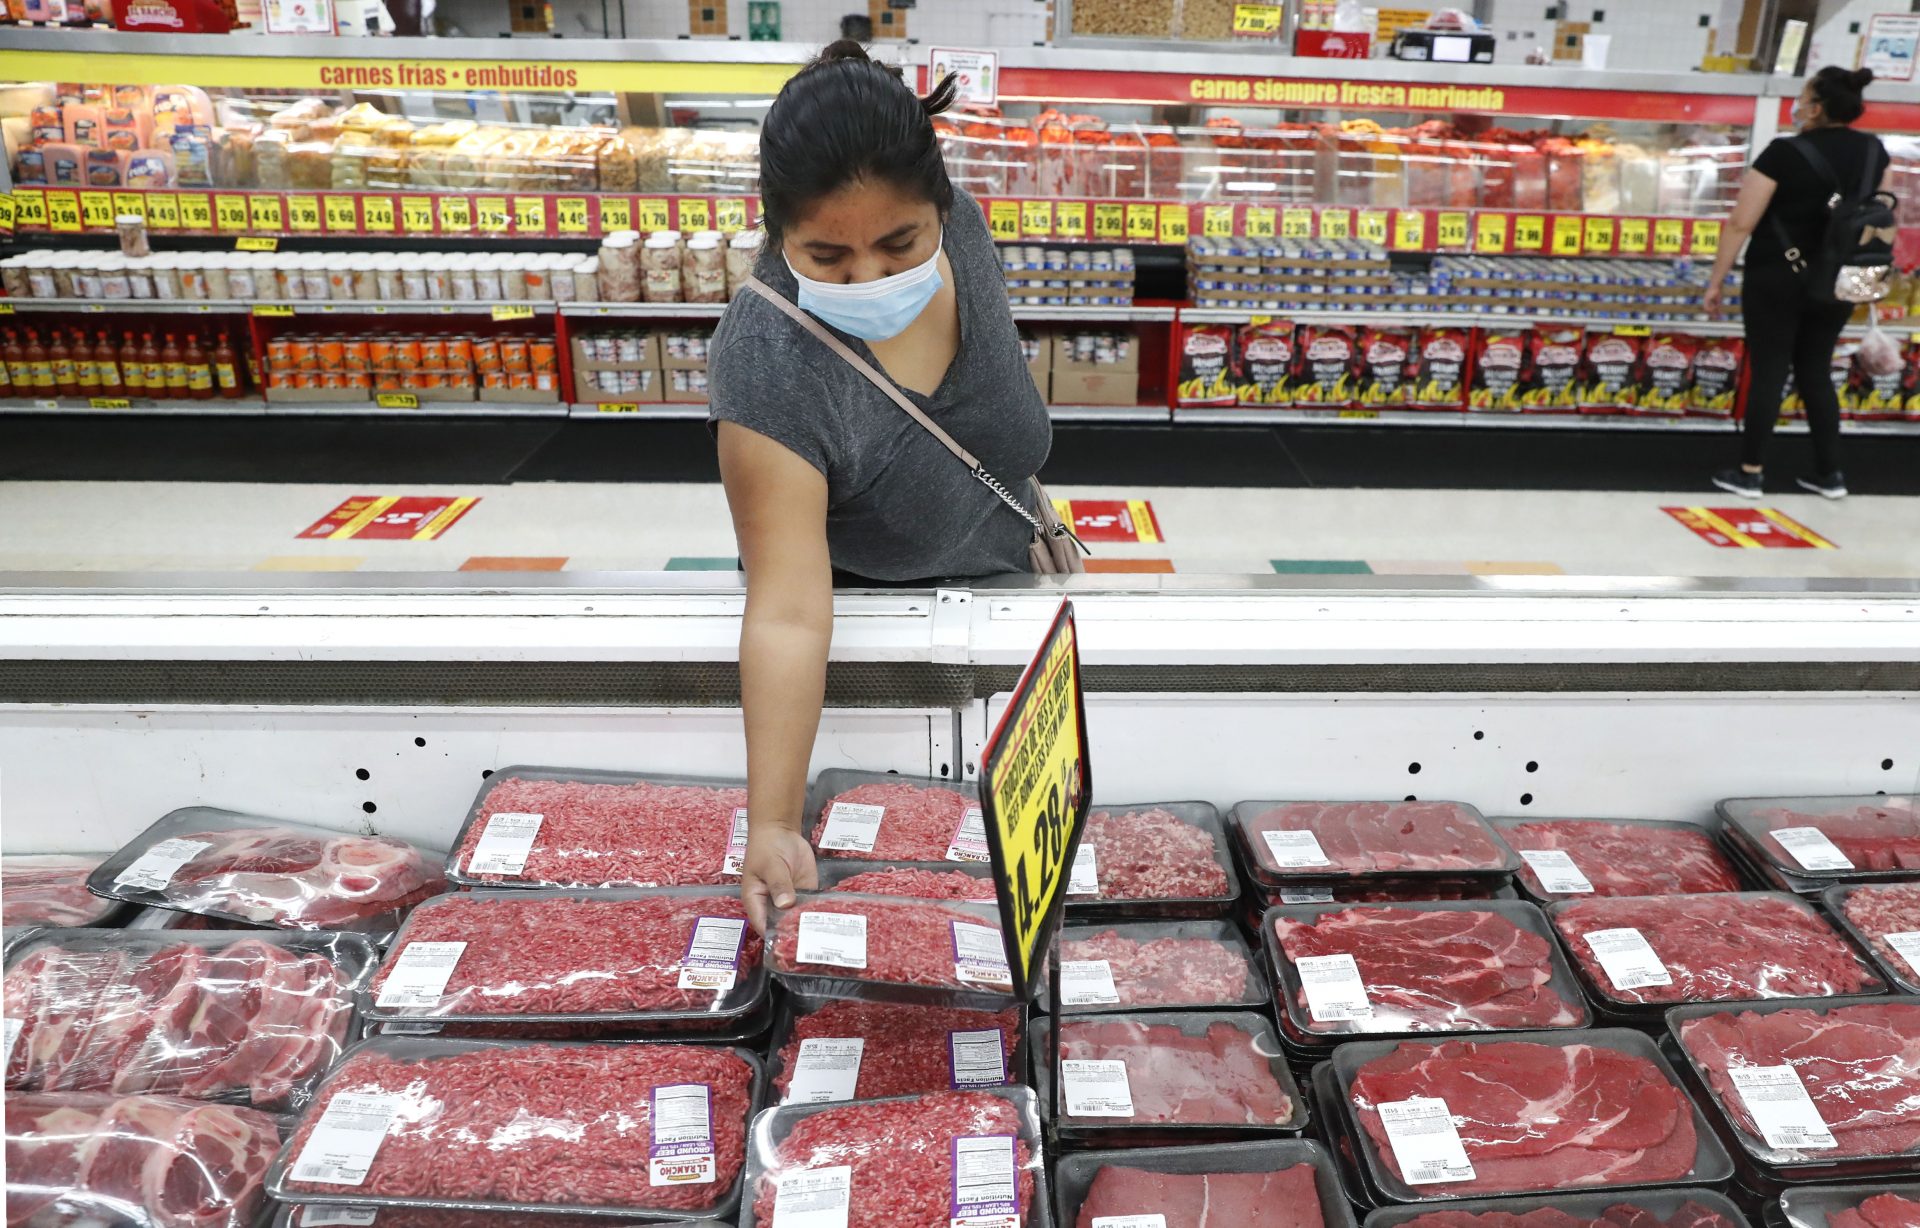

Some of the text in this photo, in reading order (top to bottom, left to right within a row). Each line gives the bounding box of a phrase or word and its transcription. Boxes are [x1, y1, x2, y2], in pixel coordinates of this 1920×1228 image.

[320, 66, 393, 86] carnes
[398, 63, 446, 86] frías
[466, 65, 577, 87] embutidos
[1190, 78, 1504, 110] carne siempre fresca marinada
[953, 851, 981, 860] RANCHO
[686, 974, 719, 983] RANCHO
[654, 1146, 711, 1157] GROUND BEEF
[659, 1164, 708, 1176] EL RANCHO
[980, 1193, 1013, 1201] Nutrition
[956, 1206, 1015, 1217] GROUND BEEF
